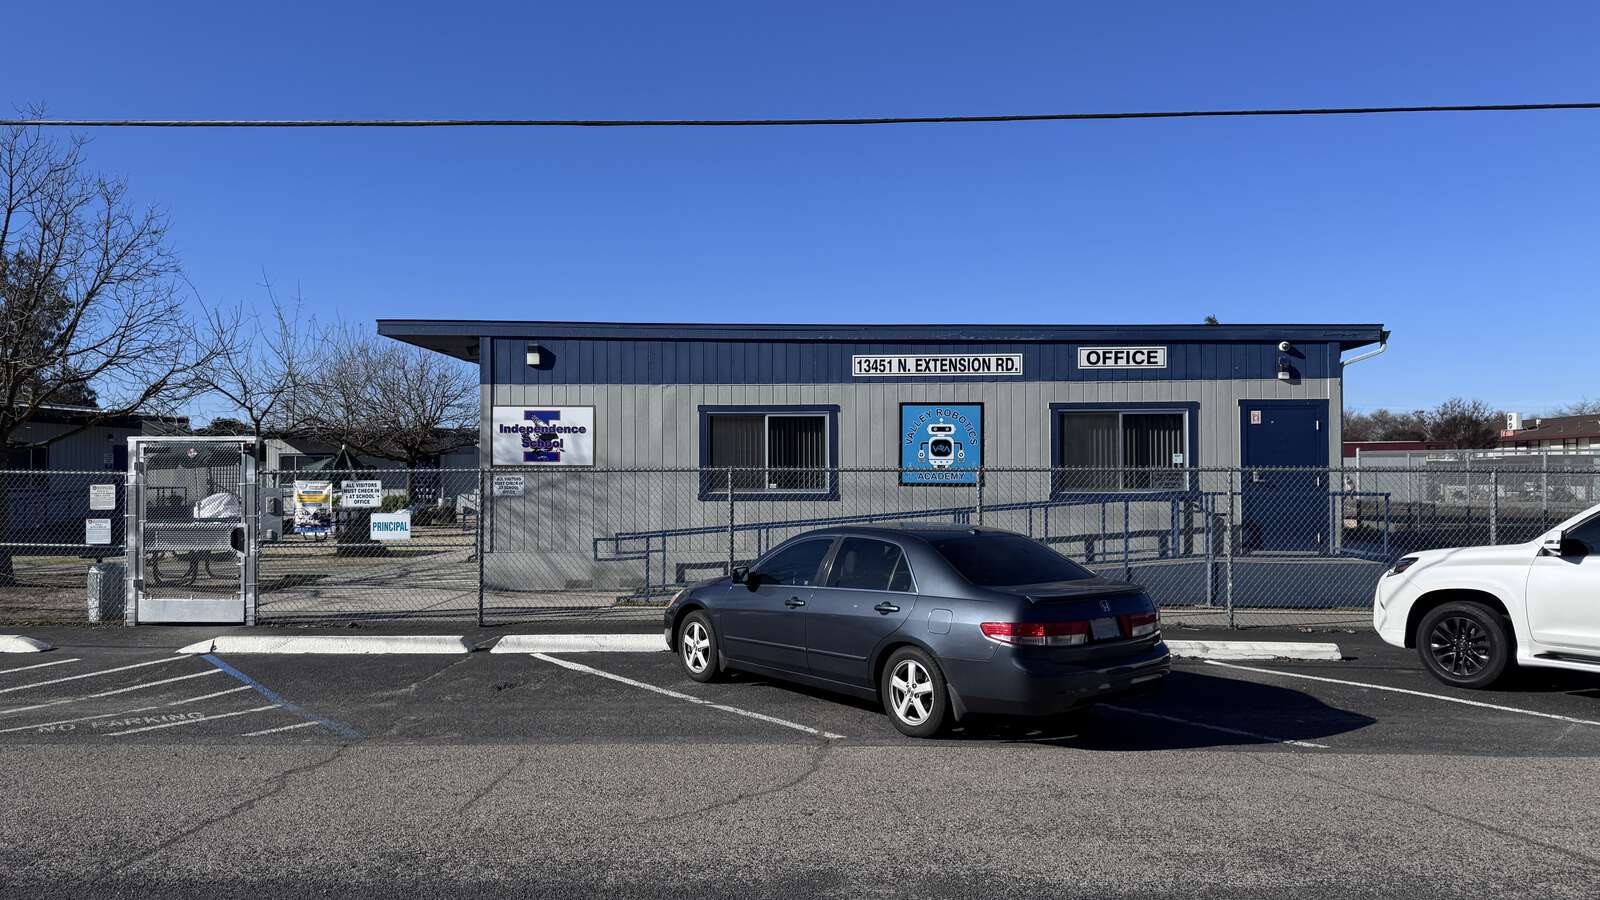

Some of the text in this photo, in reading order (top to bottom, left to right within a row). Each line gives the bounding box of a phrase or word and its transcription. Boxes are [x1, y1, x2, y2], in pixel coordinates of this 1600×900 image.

[1086, 350, 1159, 365] OFFICE
[856, 357, 1019, 373] 13451 N. EXTENSION RD.
[500, 424, 586, 435] Independence
[905, 408, 978, 446] VALLEY ROBOTICS
[522, 438, 564, 448] School
[917, 472, 965, 480] ACADEMY
[372, 522, 408, 532] PRINCIPAL
[38, 711, 205, 733] NO PARKING
